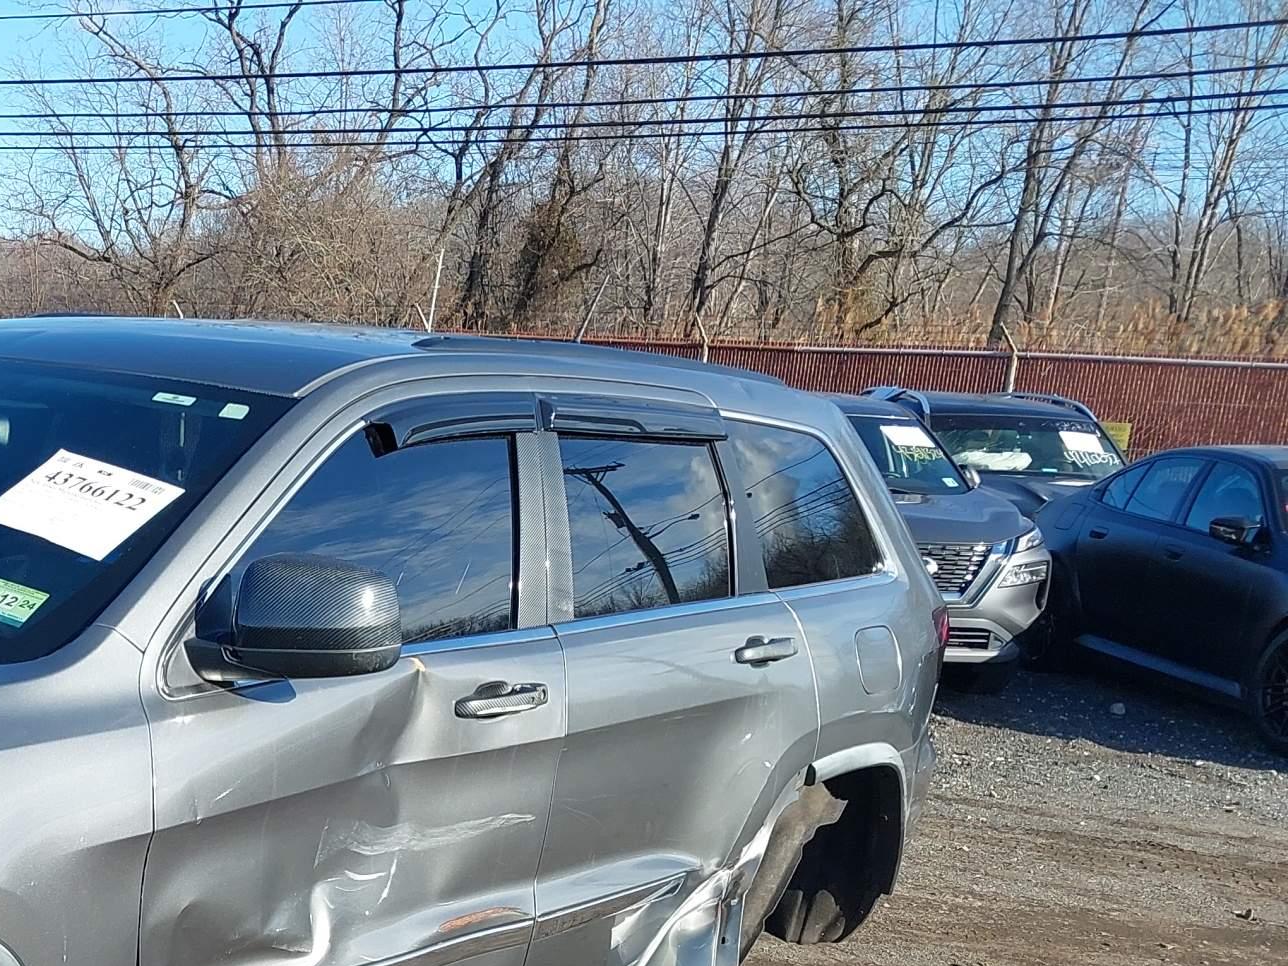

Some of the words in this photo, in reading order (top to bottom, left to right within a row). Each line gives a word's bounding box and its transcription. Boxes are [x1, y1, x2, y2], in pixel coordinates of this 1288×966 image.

[45, 471, 147, 511] 43766122
[0, 594, 19, 607] 12
[19, 600, 37, 611] 24
